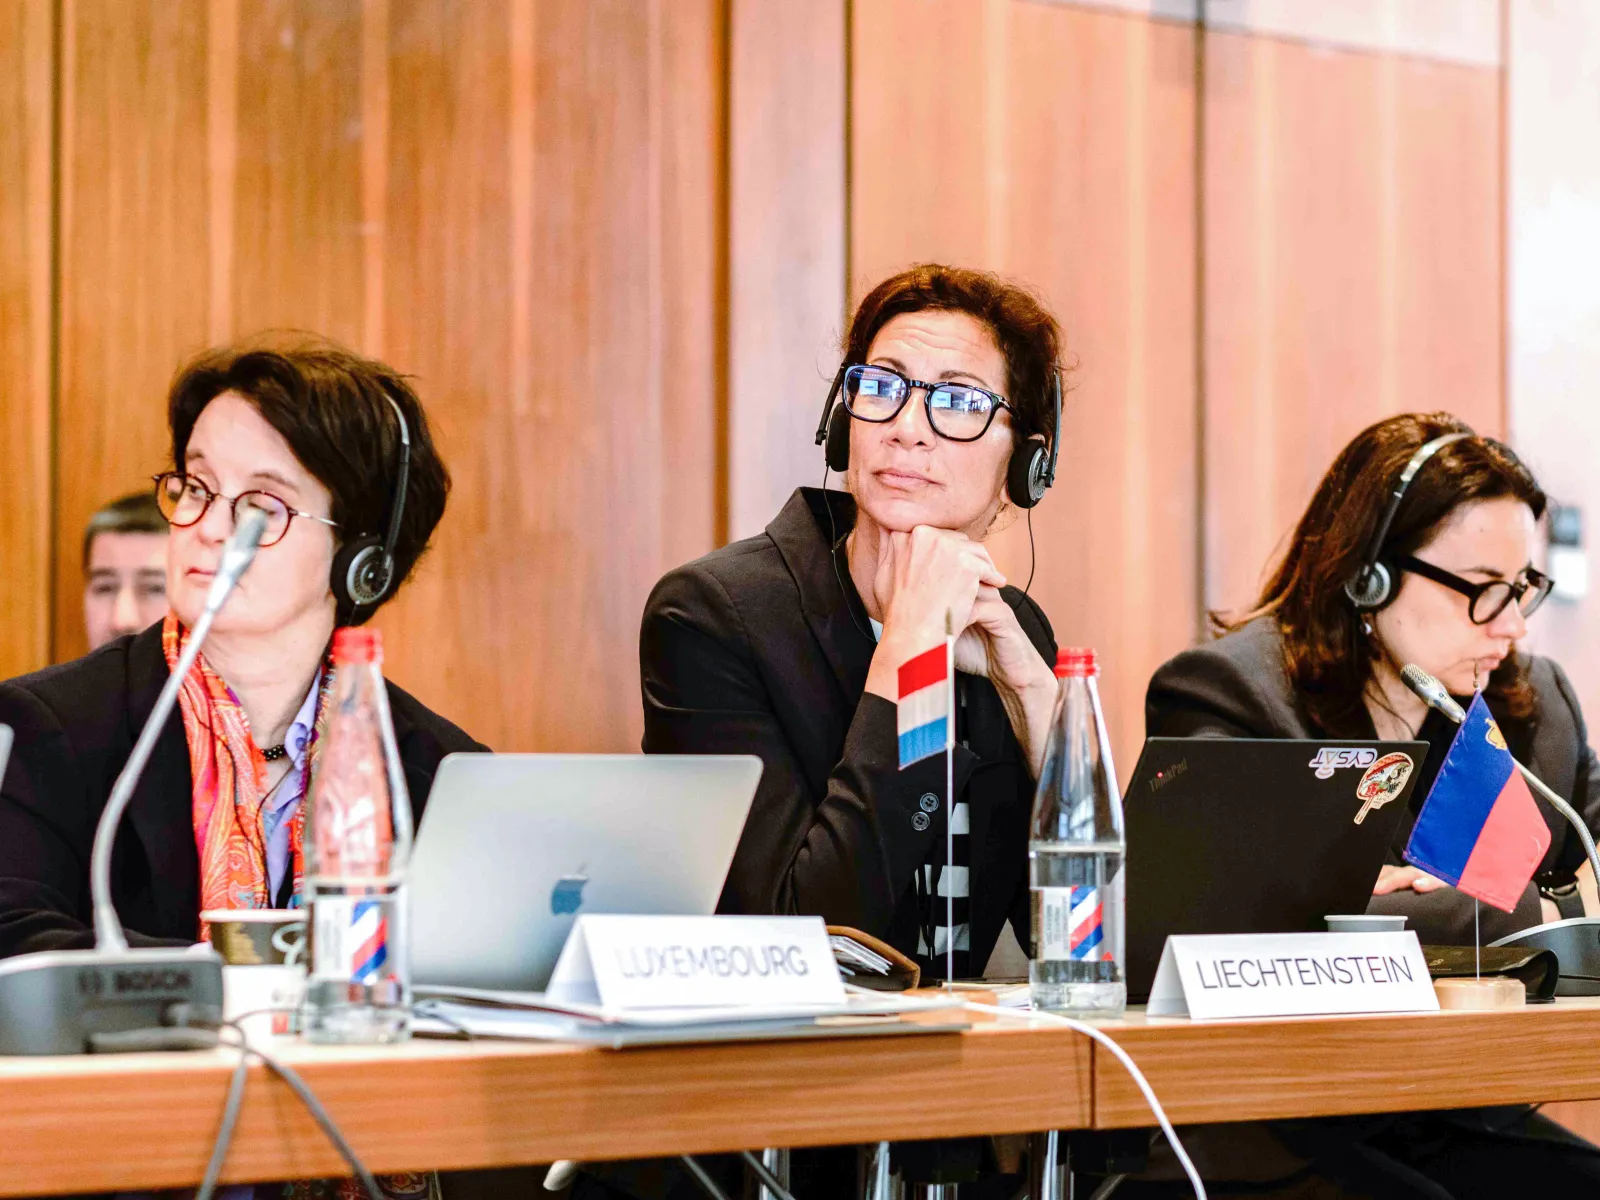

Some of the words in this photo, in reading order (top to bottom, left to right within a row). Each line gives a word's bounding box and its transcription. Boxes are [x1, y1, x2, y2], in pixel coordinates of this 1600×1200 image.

[1148, 756, 1188, 792] ThinkPad
[1312, 750, 1376, 765] CYSAT
[614, 945, 809, 978] LUXEMBOURG
[1195, 955, 1414, 989] LIECHTENSTEIN
